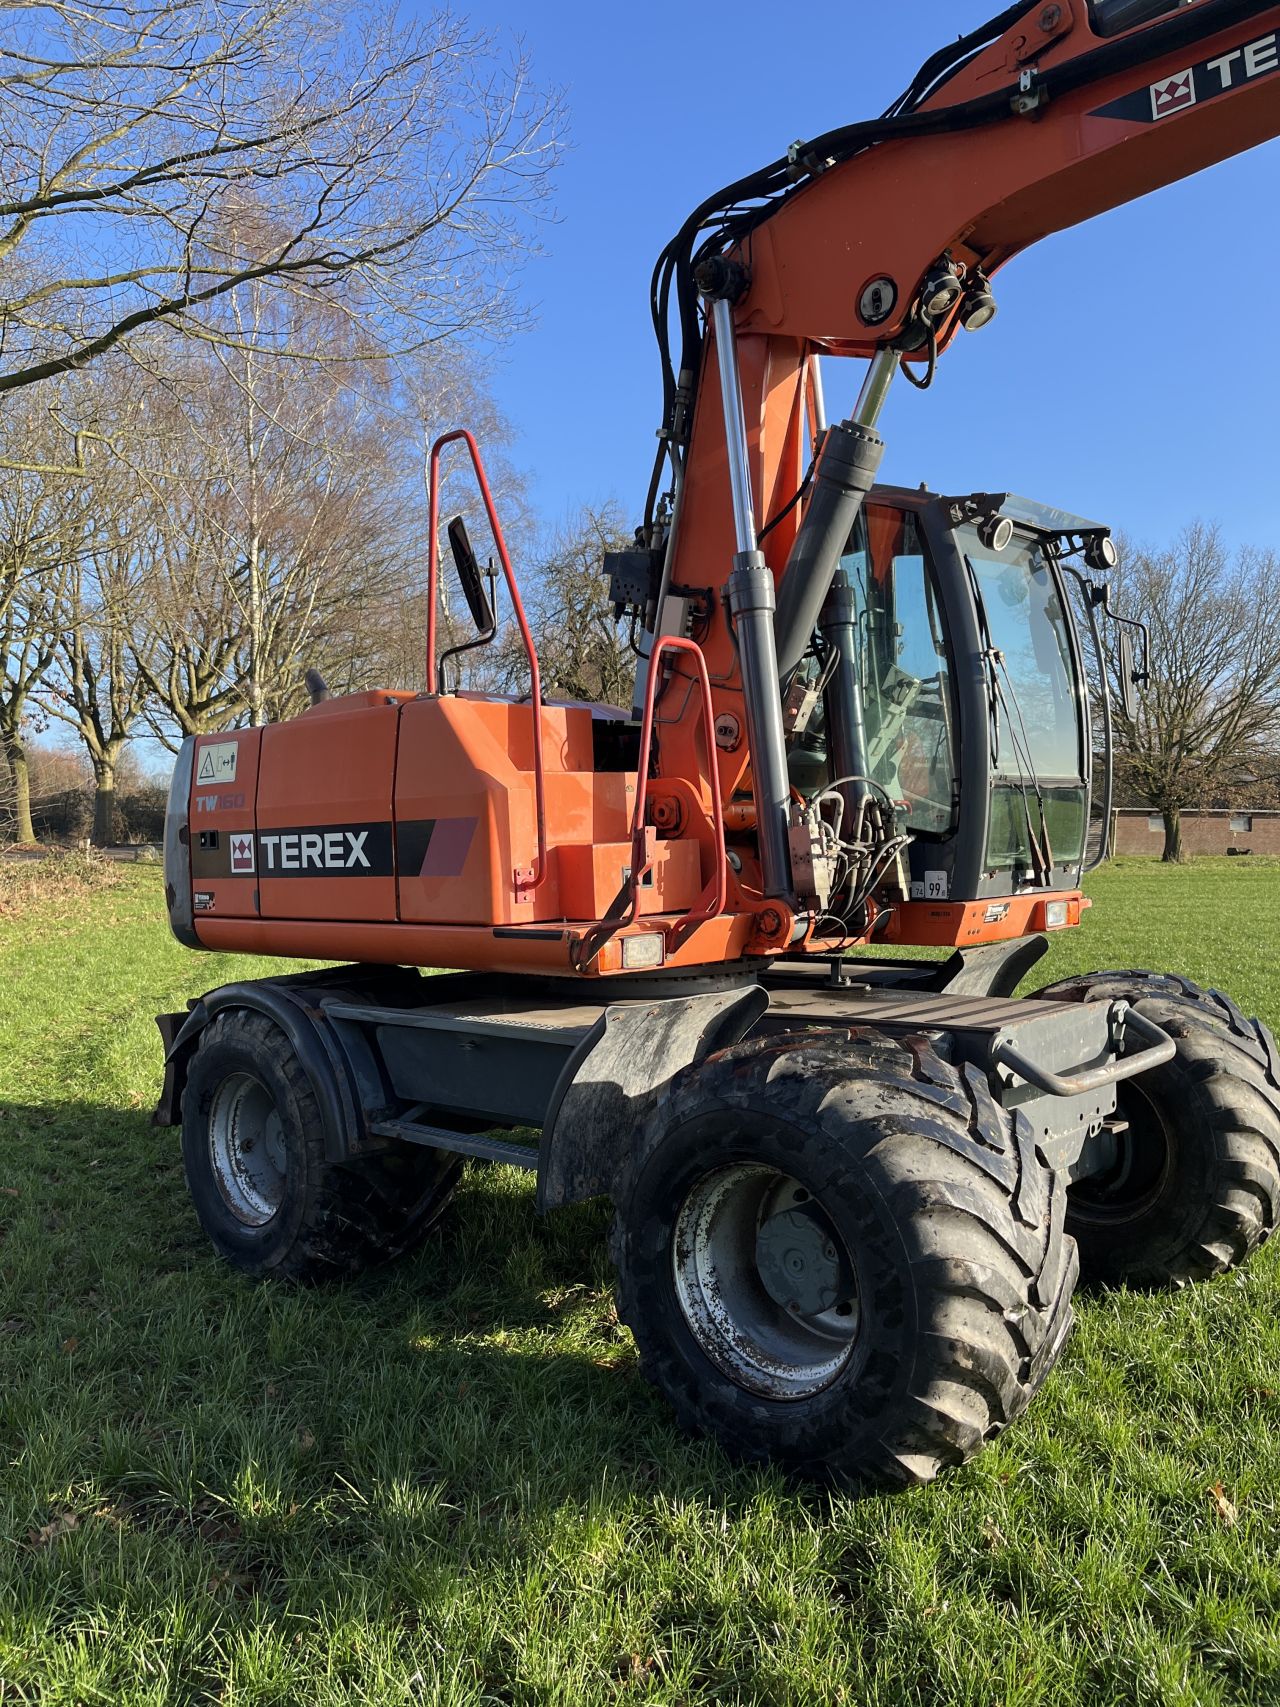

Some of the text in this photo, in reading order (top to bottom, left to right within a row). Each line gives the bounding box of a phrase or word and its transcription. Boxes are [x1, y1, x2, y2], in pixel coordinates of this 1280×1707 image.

[1207, 33, 1279, 88] TE
[195, 793, 245, 813] TW160
[260, 831, 371, 869] TEREX
[929, 882, 941, 896] 99
